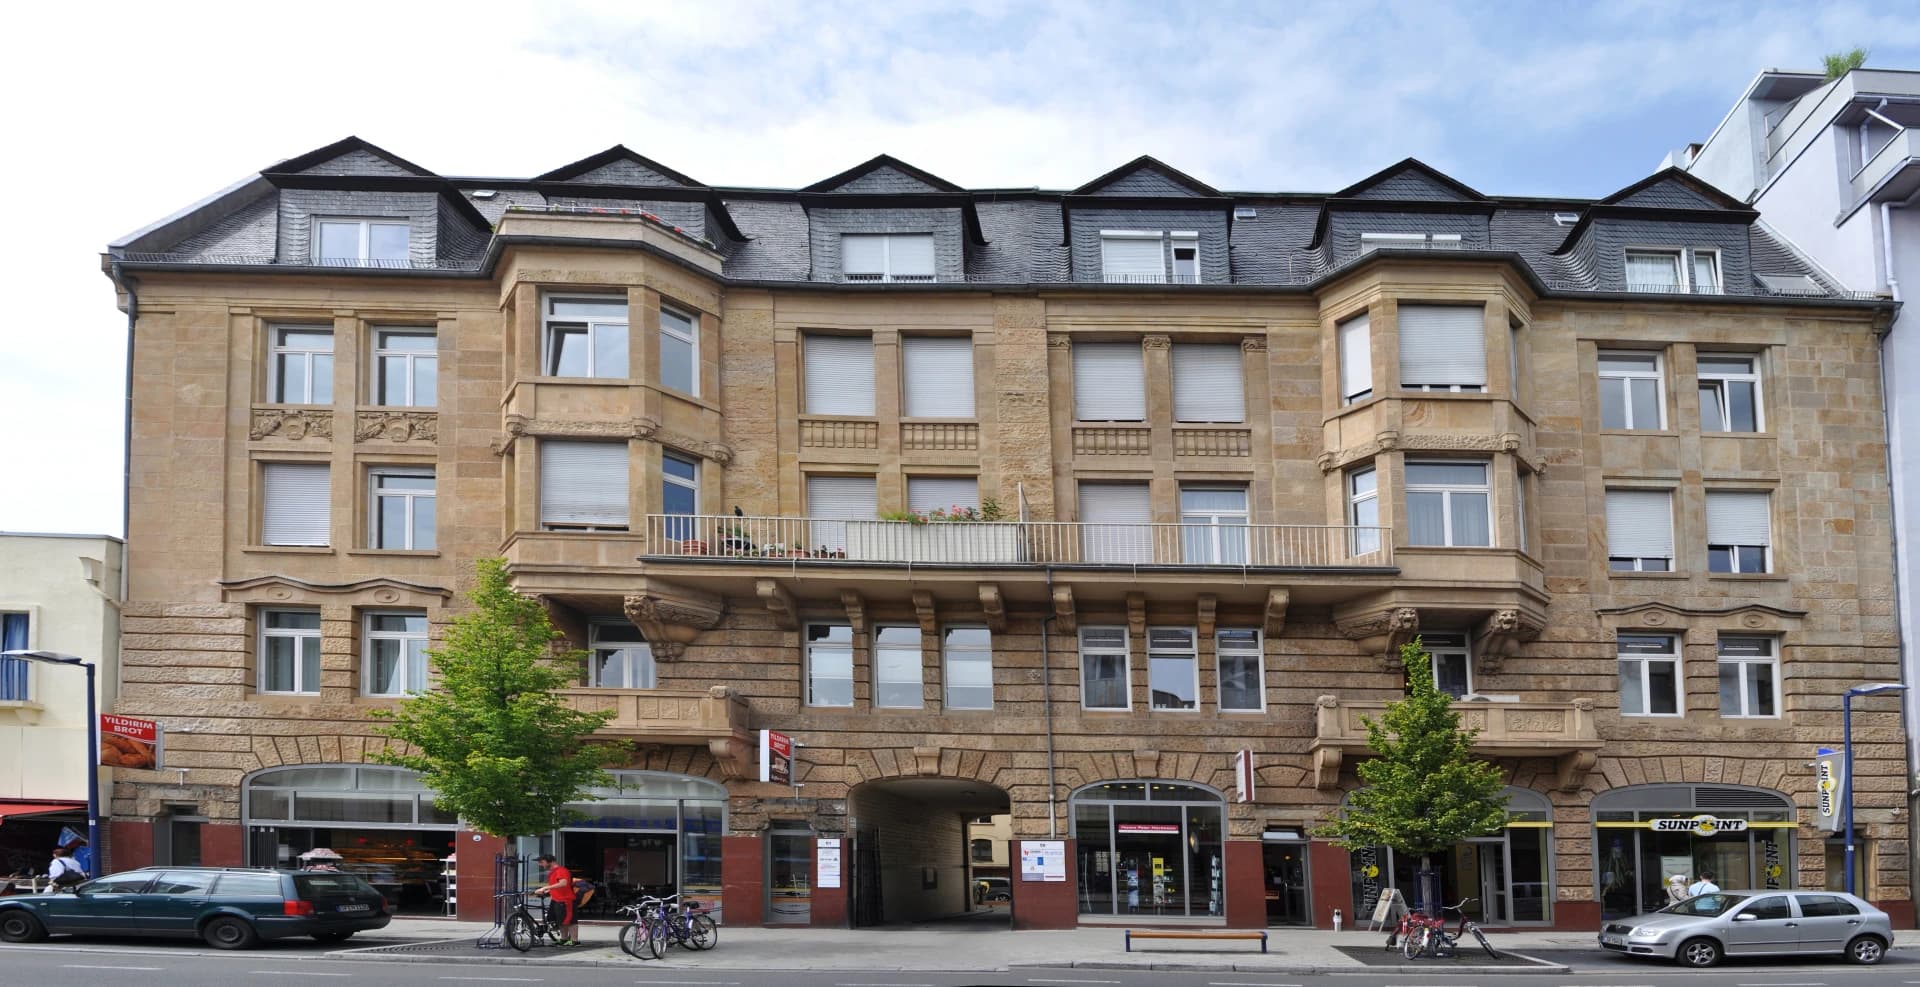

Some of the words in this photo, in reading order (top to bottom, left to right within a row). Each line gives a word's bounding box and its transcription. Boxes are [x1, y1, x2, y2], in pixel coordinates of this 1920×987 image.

[104, 716, 153, 729] YILDIRIM
[113, 725, 143, 735] BROT
[1658, 819, 1743, 831] SUNPOINT
